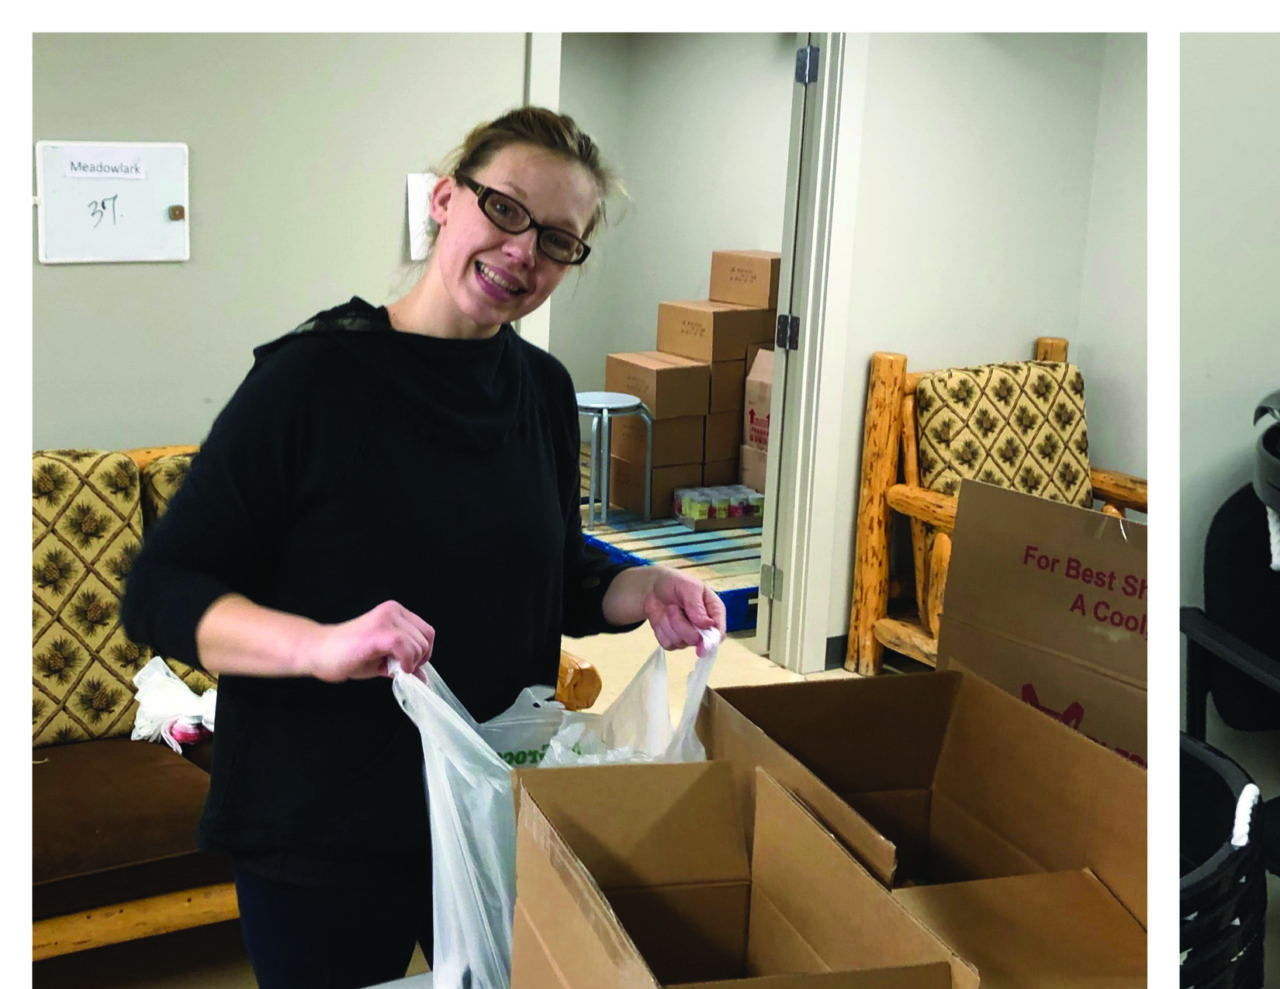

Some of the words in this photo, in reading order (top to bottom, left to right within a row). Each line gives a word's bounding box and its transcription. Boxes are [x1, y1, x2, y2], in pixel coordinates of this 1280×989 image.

[70, 161, 141, 175] Meadowlark
[1023, 545, 1060, 573] For
[1065, 557, 1116, 592] Best
[1070, 594, 1086, 616] A
